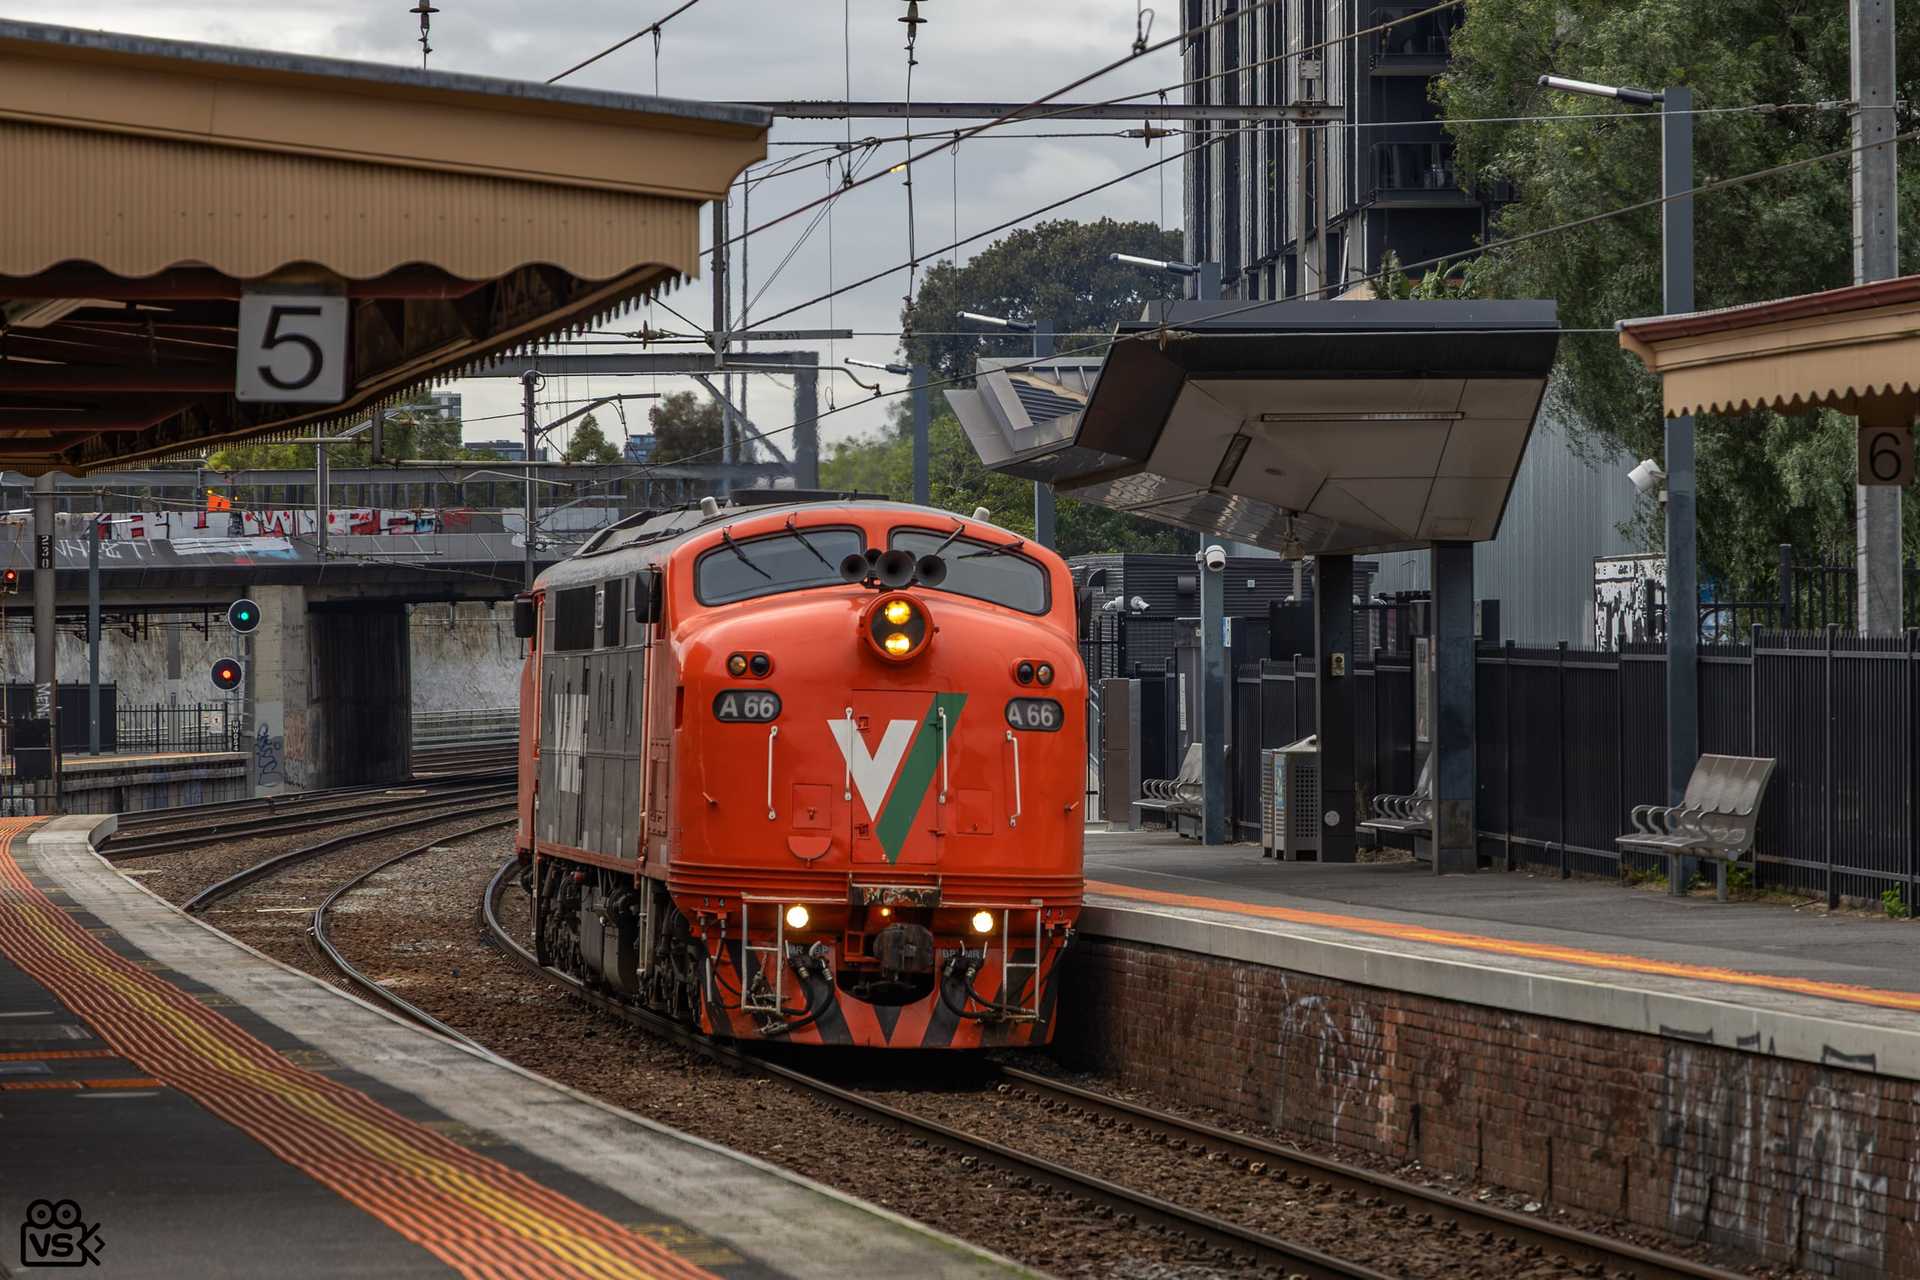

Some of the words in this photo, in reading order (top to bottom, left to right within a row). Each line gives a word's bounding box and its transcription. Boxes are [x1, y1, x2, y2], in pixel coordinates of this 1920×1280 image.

[258, 305, 324, 391] 5
[1870, 432, 1902, 482] 6
[720, 694, 739, 717] A
[744, 695, 775, 718] 66
[1008, 702, 1023, 725] A
[1027, 704, 1054, 727] 66
